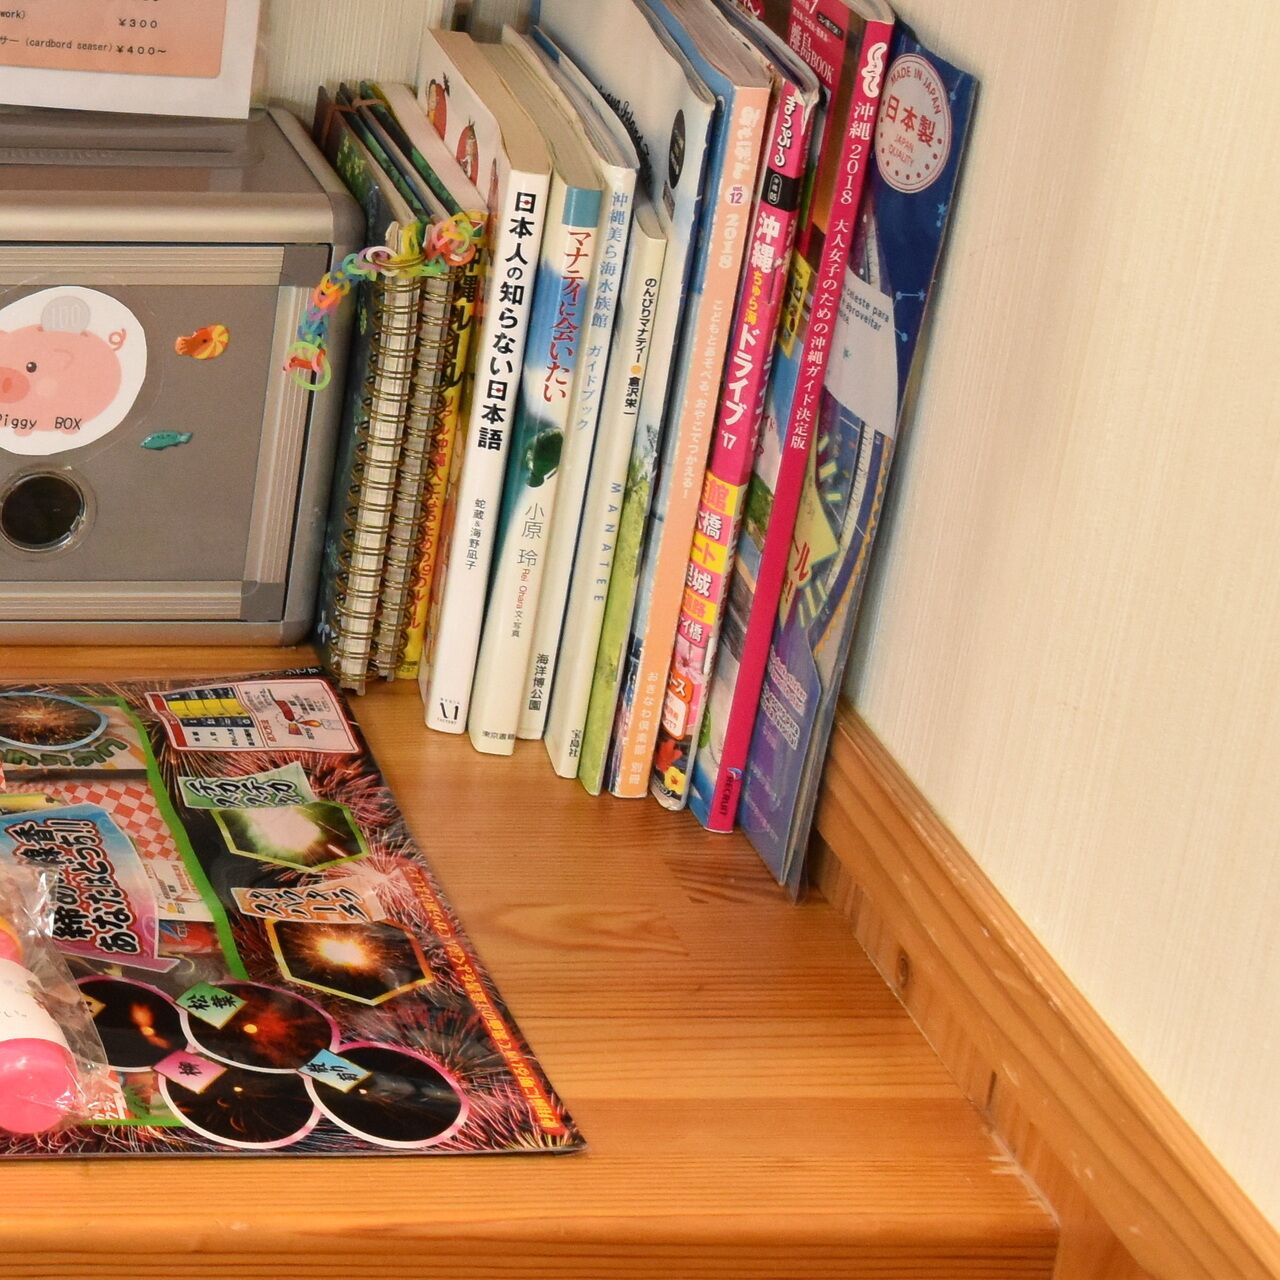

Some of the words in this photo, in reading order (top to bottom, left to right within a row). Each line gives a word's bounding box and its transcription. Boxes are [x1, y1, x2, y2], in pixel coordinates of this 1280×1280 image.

[0, 9, 27, 20] work)
[850, 101, 874, 141] 沖縄
[886, 94, 937, 148] 日本製
[890, 66, 911, 87] MADE
[914, 66, 922, 82] IN
[923, 76, 943, 116] JAPAN
[774, 95, 797, 167] まっぷる
[729, 191, 743, 205] 12
[840, 144, 863, 205] 2018
[590, 191, 629, 330] 沖縄美ら海水族館
[719, 212, 739, 270] 2018
[751, 211, 781, 274] 沖縄
[477, 191, 537, 452] 日本人の知らない日本語
[542, 229, 593, 403] マナティに会いたい
[633, 277, 658, 364] のんびりマナティー
[790, 219, 850, 450] 大人女子のための沖縄ガイド決定版
[575, 344, 603, 431] ガイドブック
[725, 324, 762, 426] ドライブ
[54, 416, 83, 431] BOX
[521, 502, 546, 541] 小原
[594, 481, 623, 603] MANATEE
[516, 548, 539, 569] 玲
[719, 775, 735, 818] RECRUIT
